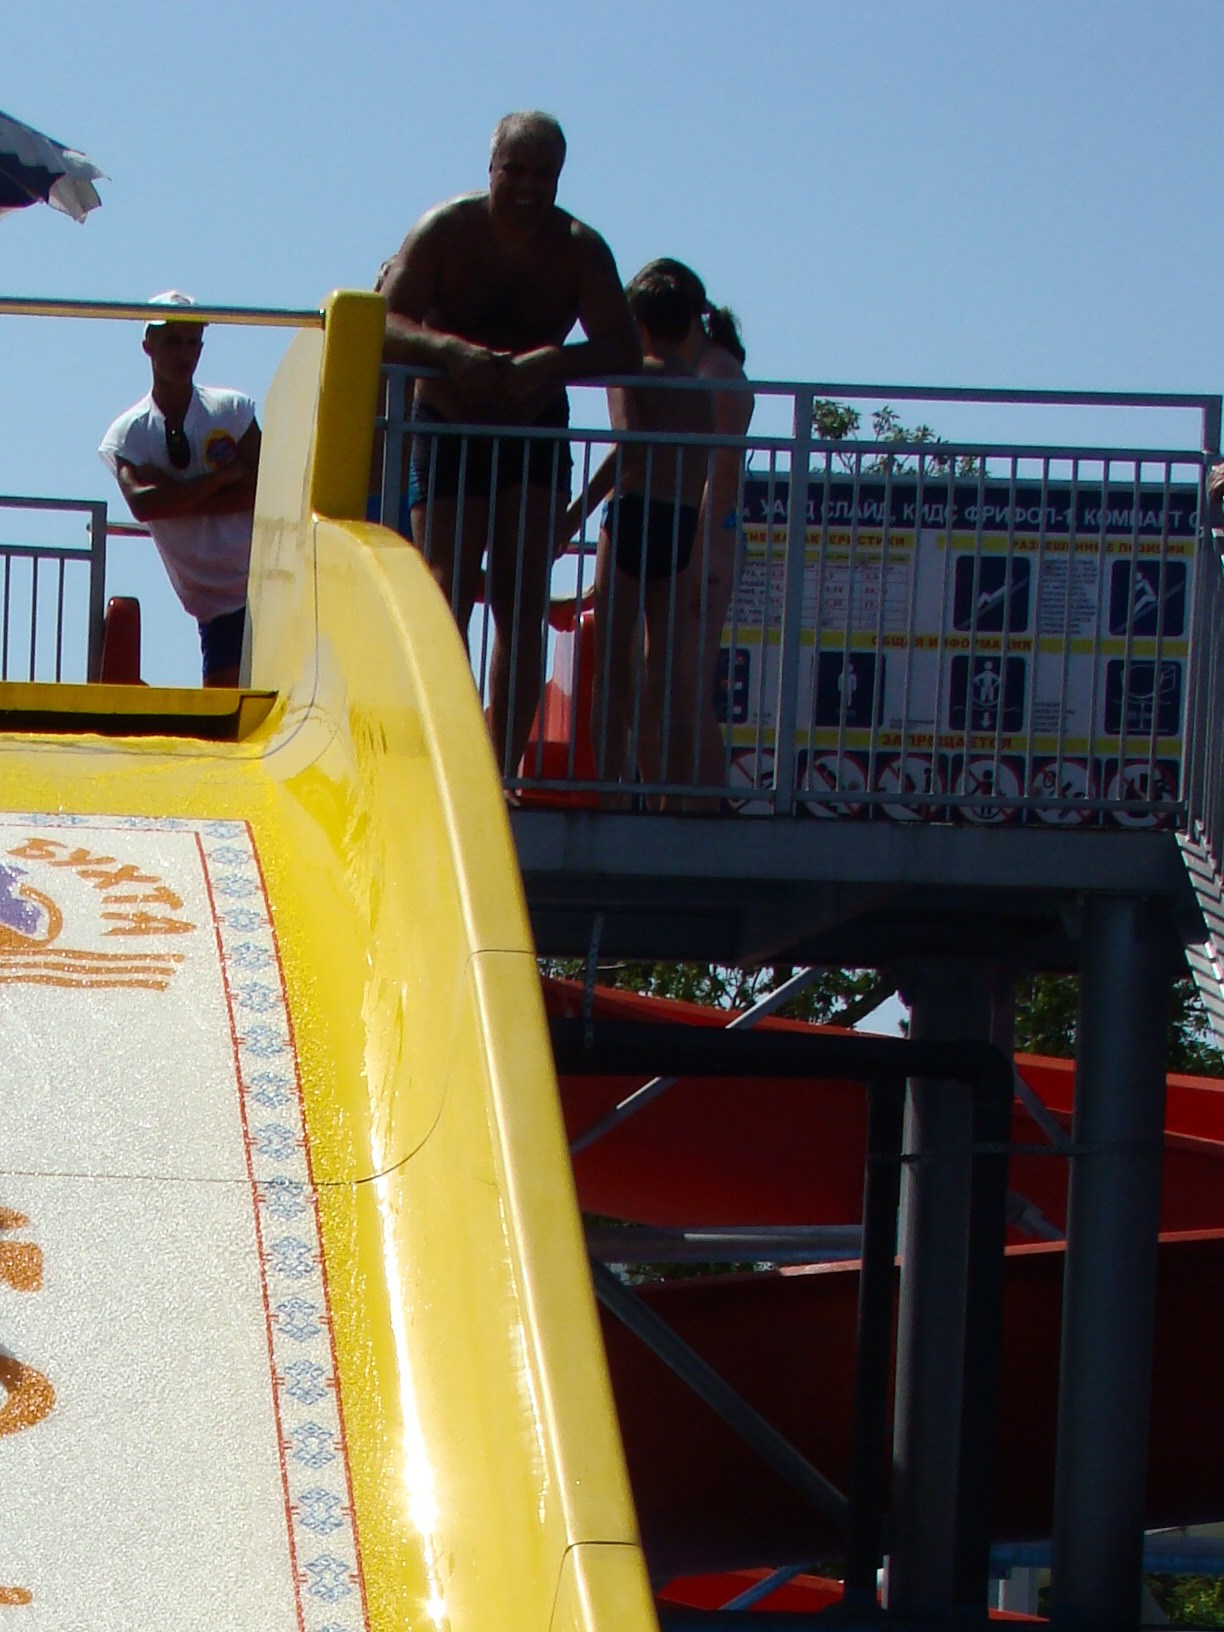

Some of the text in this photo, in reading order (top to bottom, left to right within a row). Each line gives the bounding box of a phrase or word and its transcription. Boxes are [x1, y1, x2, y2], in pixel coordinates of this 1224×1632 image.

[760, 499, 814, 521] УАД
[872, 636, 923, 649] ОБЩЯ
[6, 836, 198, 938] БУХТА
